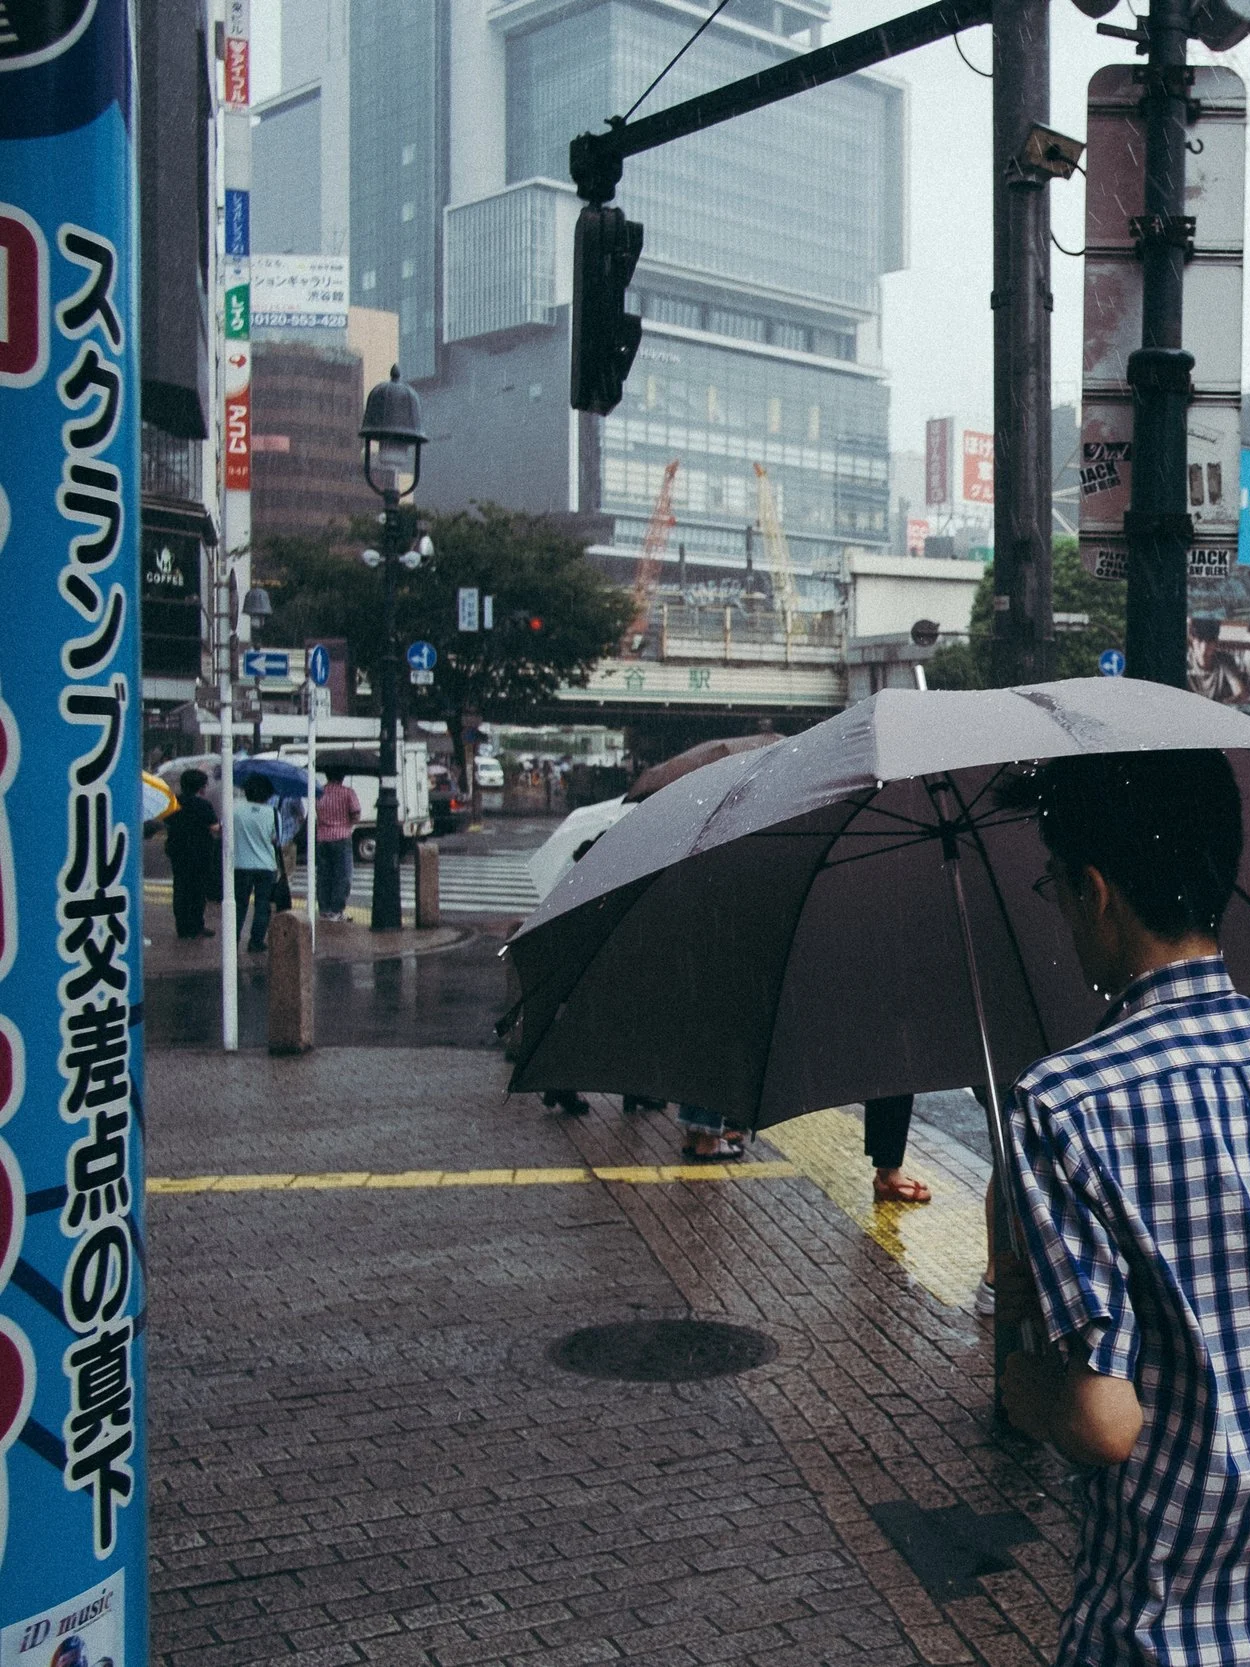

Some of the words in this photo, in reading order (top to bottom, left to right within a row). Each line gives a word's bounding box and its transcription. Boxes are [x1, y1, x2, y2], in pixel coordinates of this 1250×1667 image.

[231, 295, 245, 332] レイク
[228, 405, 248, 454] アコム
[1080, 459, 1118, 485] JACK
[1190, 550, 1227, 565] JACK
[146, 571, 184, 587] COFFEE
[56, 222, 131, 1560] スクランブル交差点の真下
[20, 1619, 51, 1653] iD
[56, 1588, 114, 1637] music
